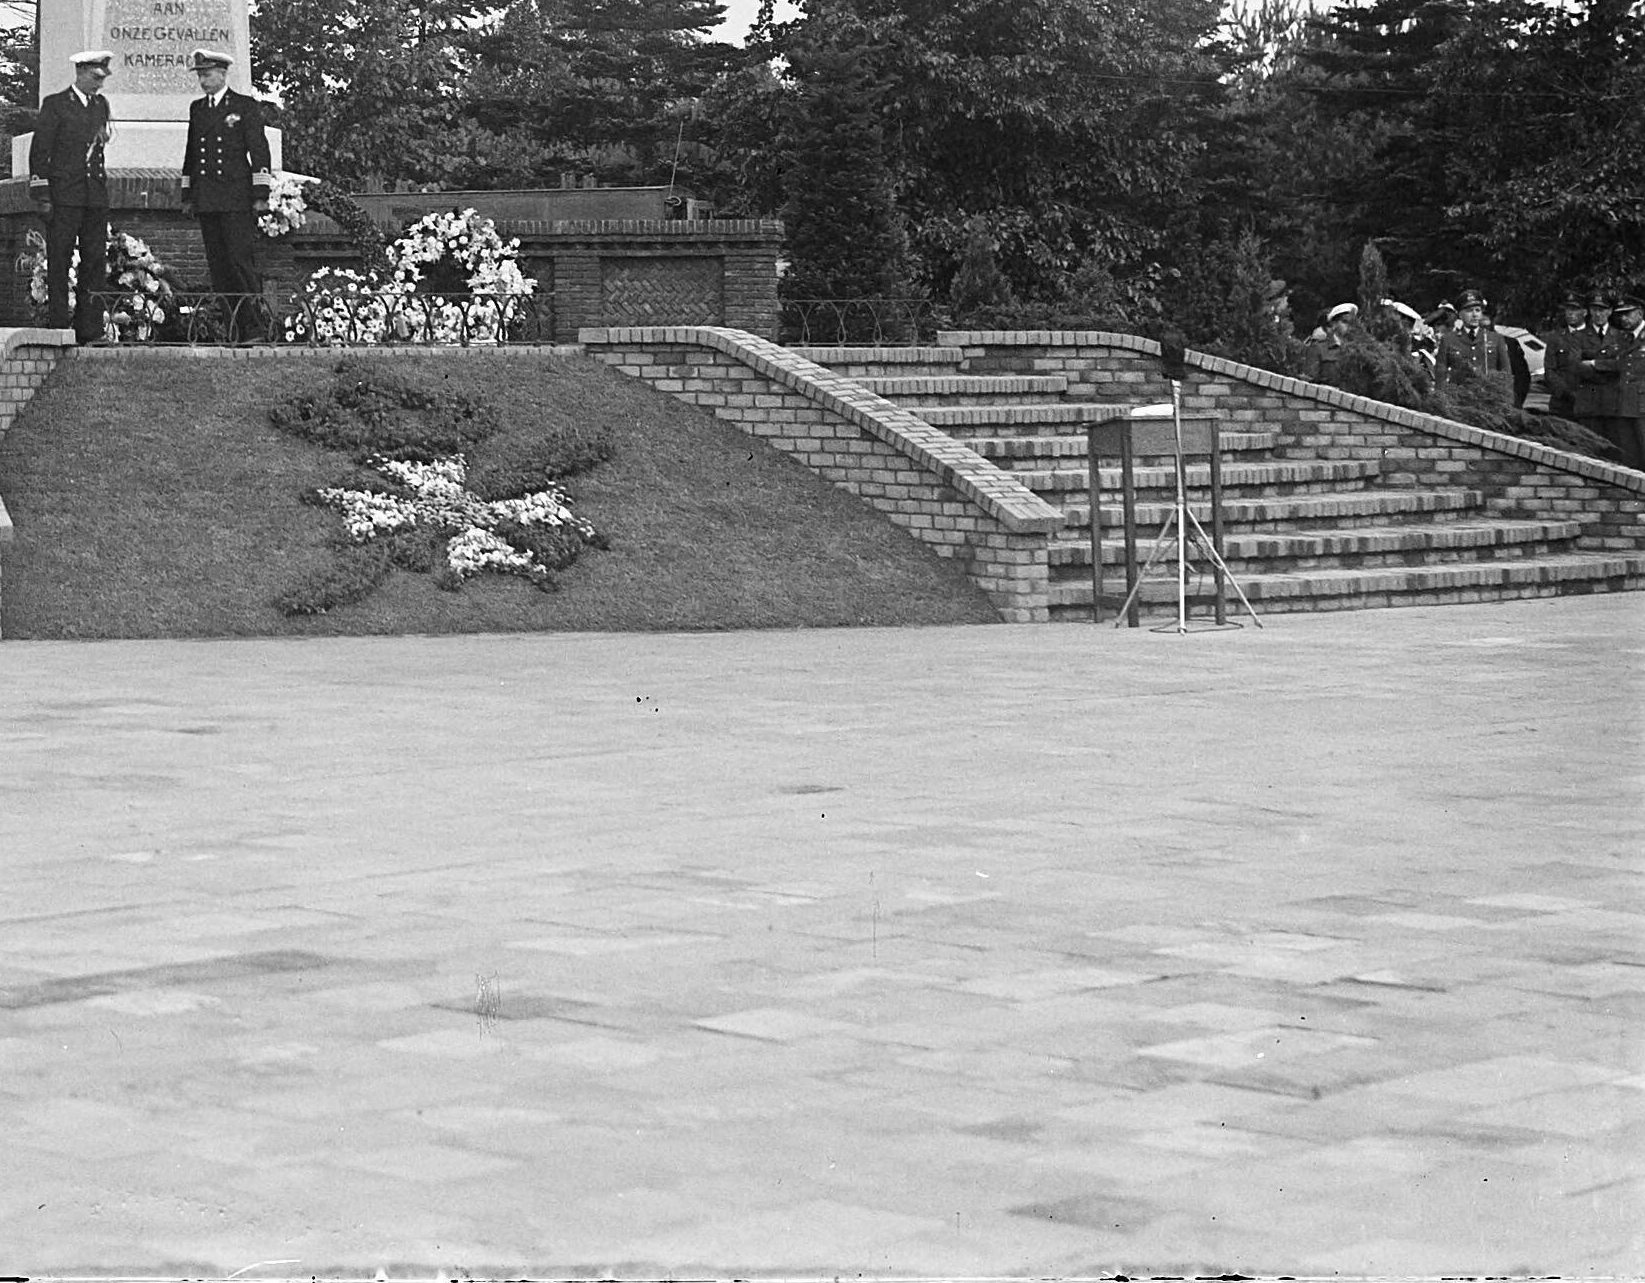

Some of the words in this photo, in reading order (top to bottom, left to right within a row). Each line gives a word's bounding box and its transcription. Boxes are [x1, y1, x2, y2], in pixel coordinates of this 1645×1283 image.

[153, 2, 185, 15] AAN
[110, 27, 151, 41] ONZE
[154, 27, 229, 42] GEVALLEN
